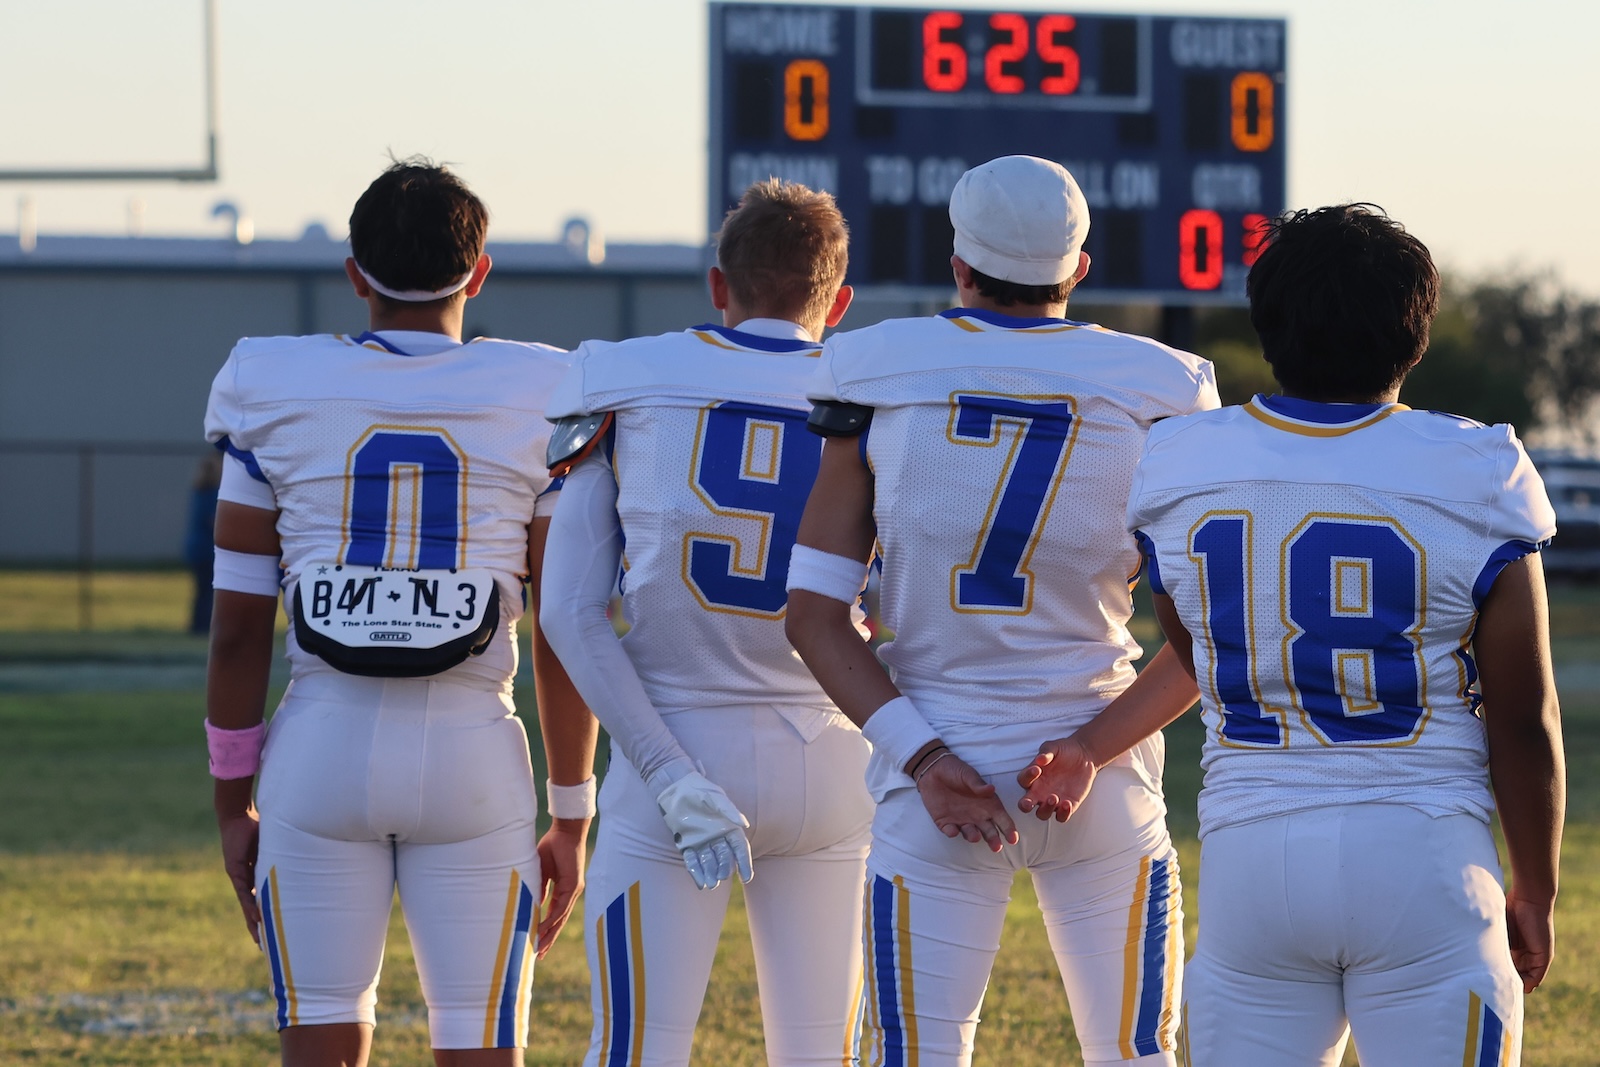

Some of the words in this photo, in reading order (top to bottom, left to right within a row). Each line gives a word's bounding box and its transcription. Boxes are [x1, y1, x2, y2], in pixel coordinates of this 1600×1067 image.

[727, 10, 839, 56] HOME
[1170, 21, 1280, 69] GUEST
[783, 58, 830, 142] 0
[1231, 71, 1274, 153] 0
[866, 156, 914, 205] TO
[1178, 208, 1224, 291] 0
[337, 424, 468, 568] 0
[683, 400, 823, 620] 9
[948, 391, 1082, 615] 7
[373, 633, 409, 641] BATTLE
[415, 621, 442, 629] State
[1188, 509, 1434, 749] 18
